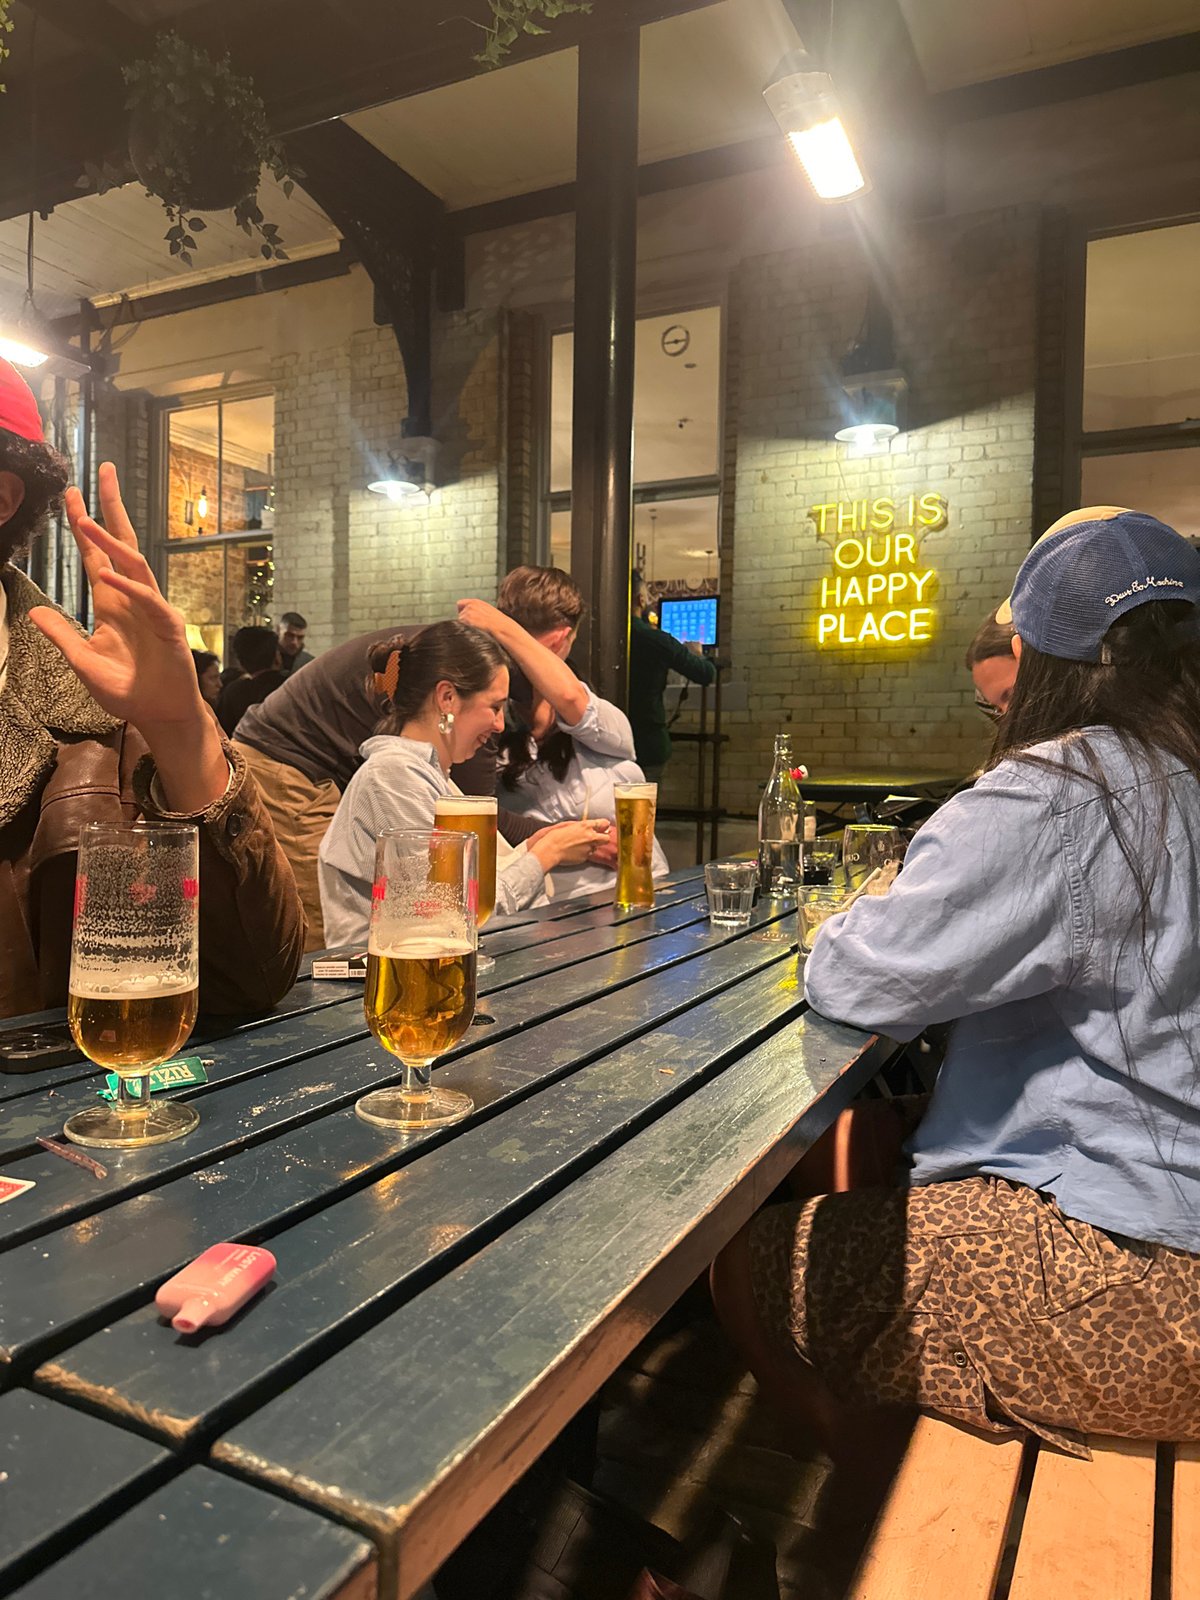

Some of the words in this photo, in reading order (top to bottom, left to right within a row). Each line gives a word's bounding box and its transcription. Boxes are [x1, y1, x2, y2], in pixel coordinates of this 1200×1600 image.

[812, 497, 894, 533] THIS
[908, 492, 942, 526] IS
[834, 533, 915, 569] OUR
[821, 569, 935, 608] HAPPY
[818, 608, 933, 643] PLACE
